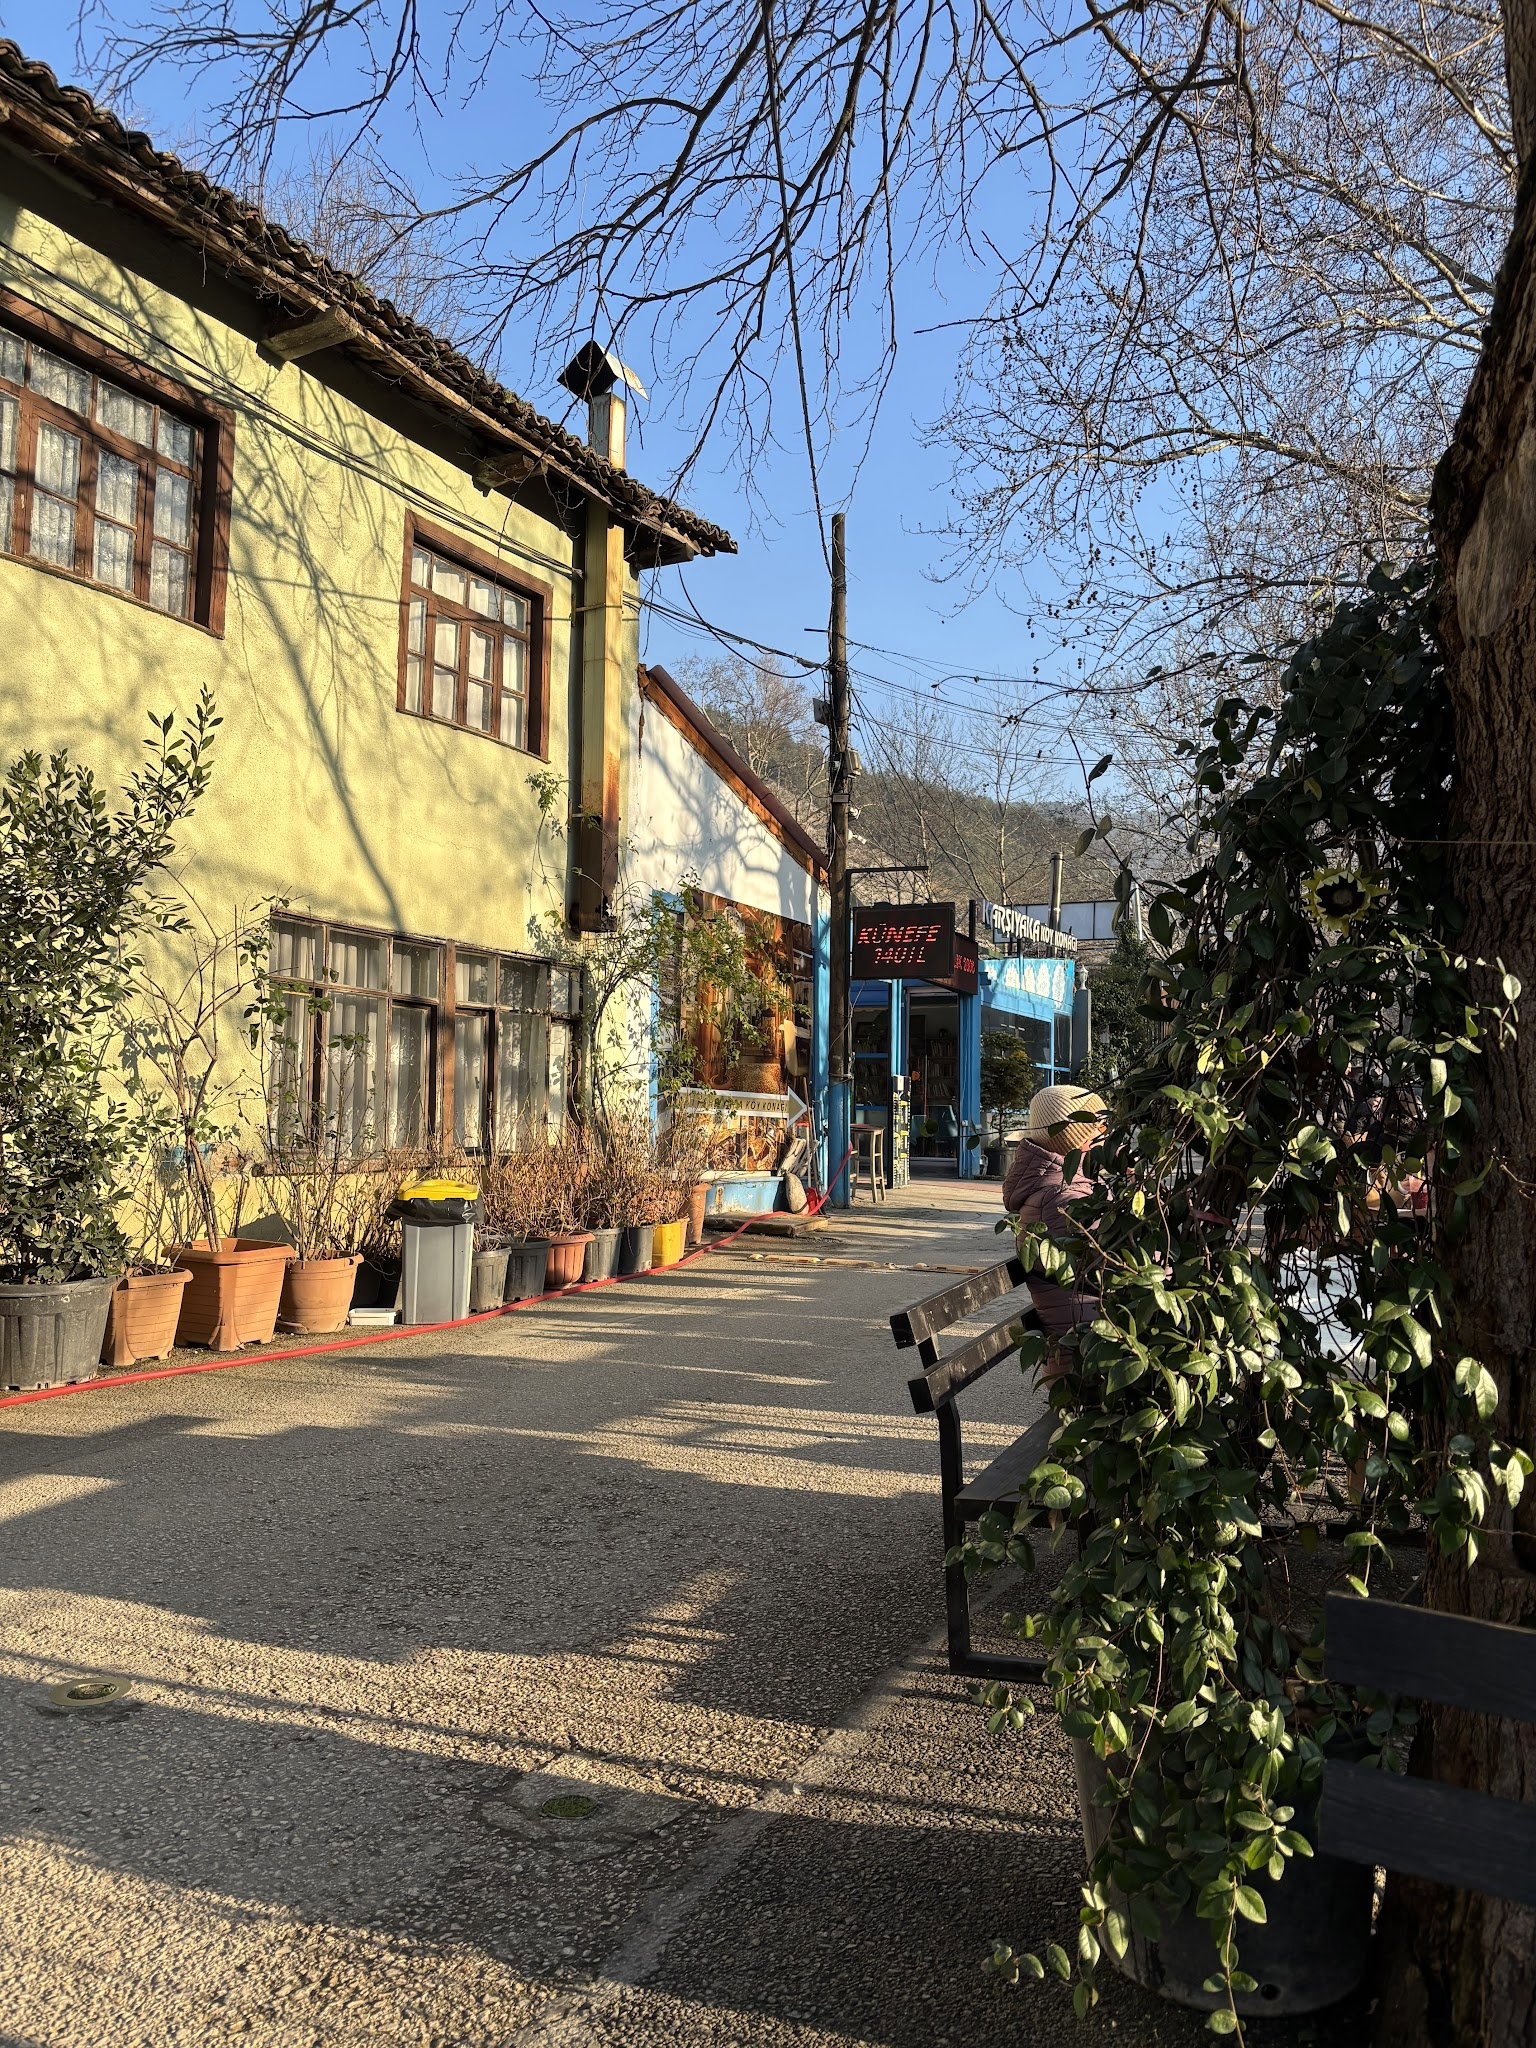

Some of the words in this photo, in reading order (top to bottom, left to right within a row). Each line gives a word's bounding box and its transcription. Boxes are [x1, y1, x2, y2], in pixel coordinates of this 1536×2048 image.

[857, 923, 942, 945] KÜNEFE
[983, 899, 1041, 943] KARŞIYAKA
[1040, 923, 1054, 945] KÖY
[1054, 930, 1078, 952] KONAĞI
